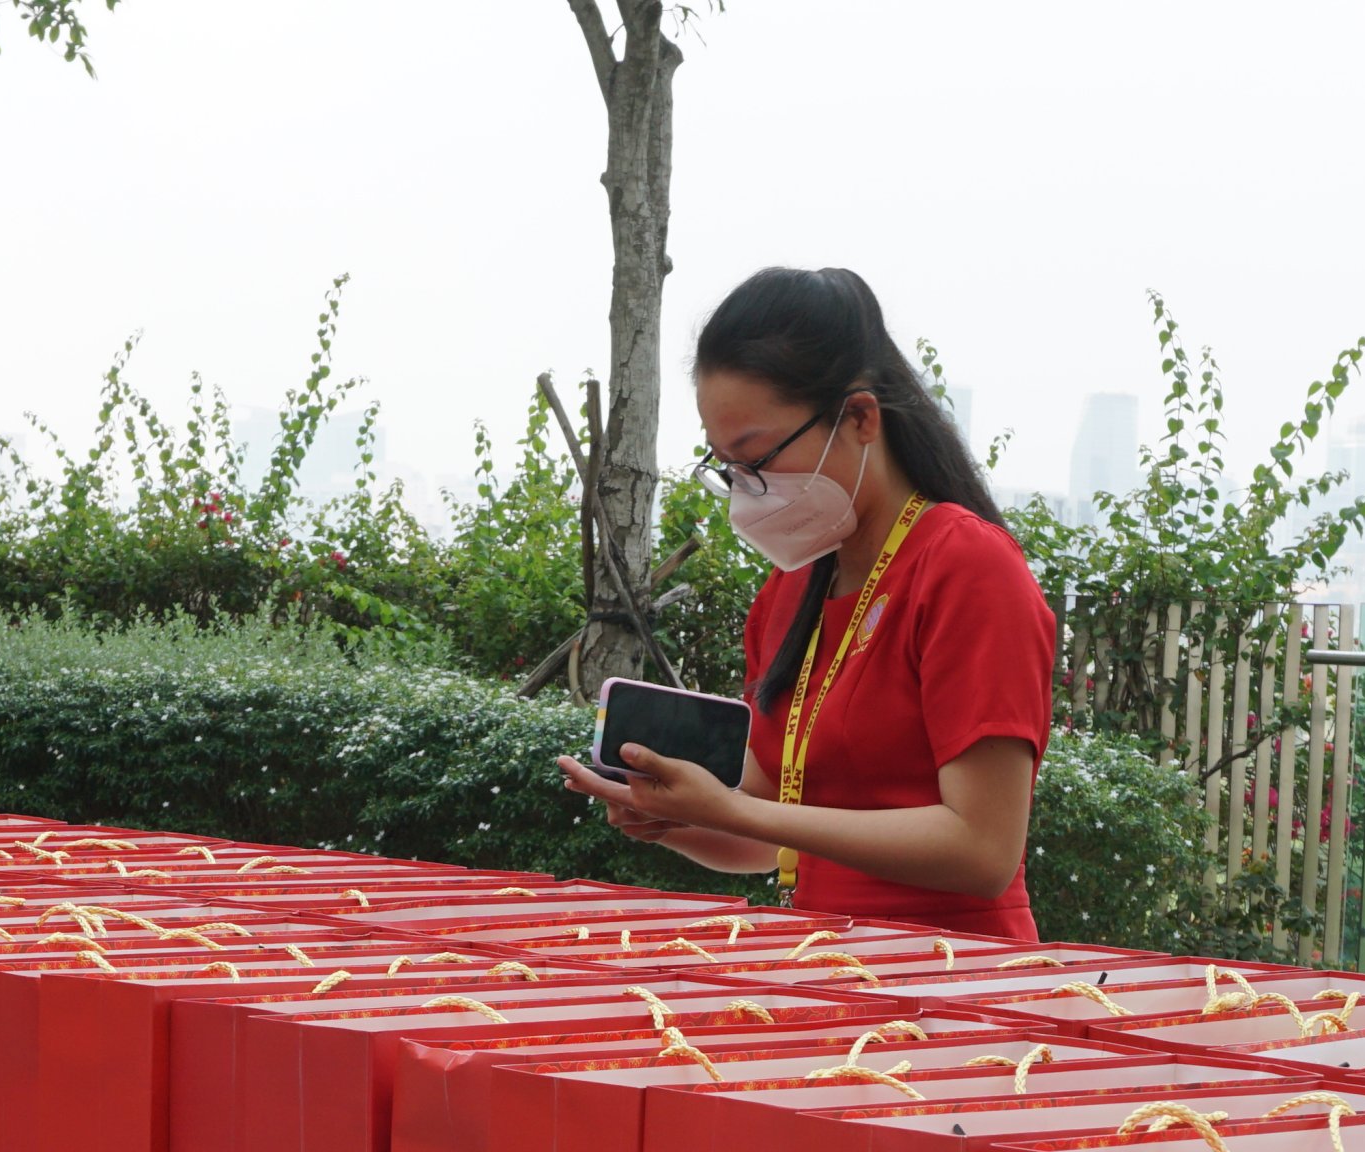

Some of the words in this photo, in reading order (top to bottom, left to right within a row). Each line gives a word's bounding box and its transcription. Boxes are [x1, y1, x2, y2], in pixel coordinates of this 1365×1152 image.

[875, 550, 893, 576] MY
[849, 577, 877, 632] HOUSE
[787, 711, 798, 737] MY
[793, 656, 813, 708] HOUSE
[826, 658, 840, 682] MY
[804, 685, 828, 740] HOUSE
